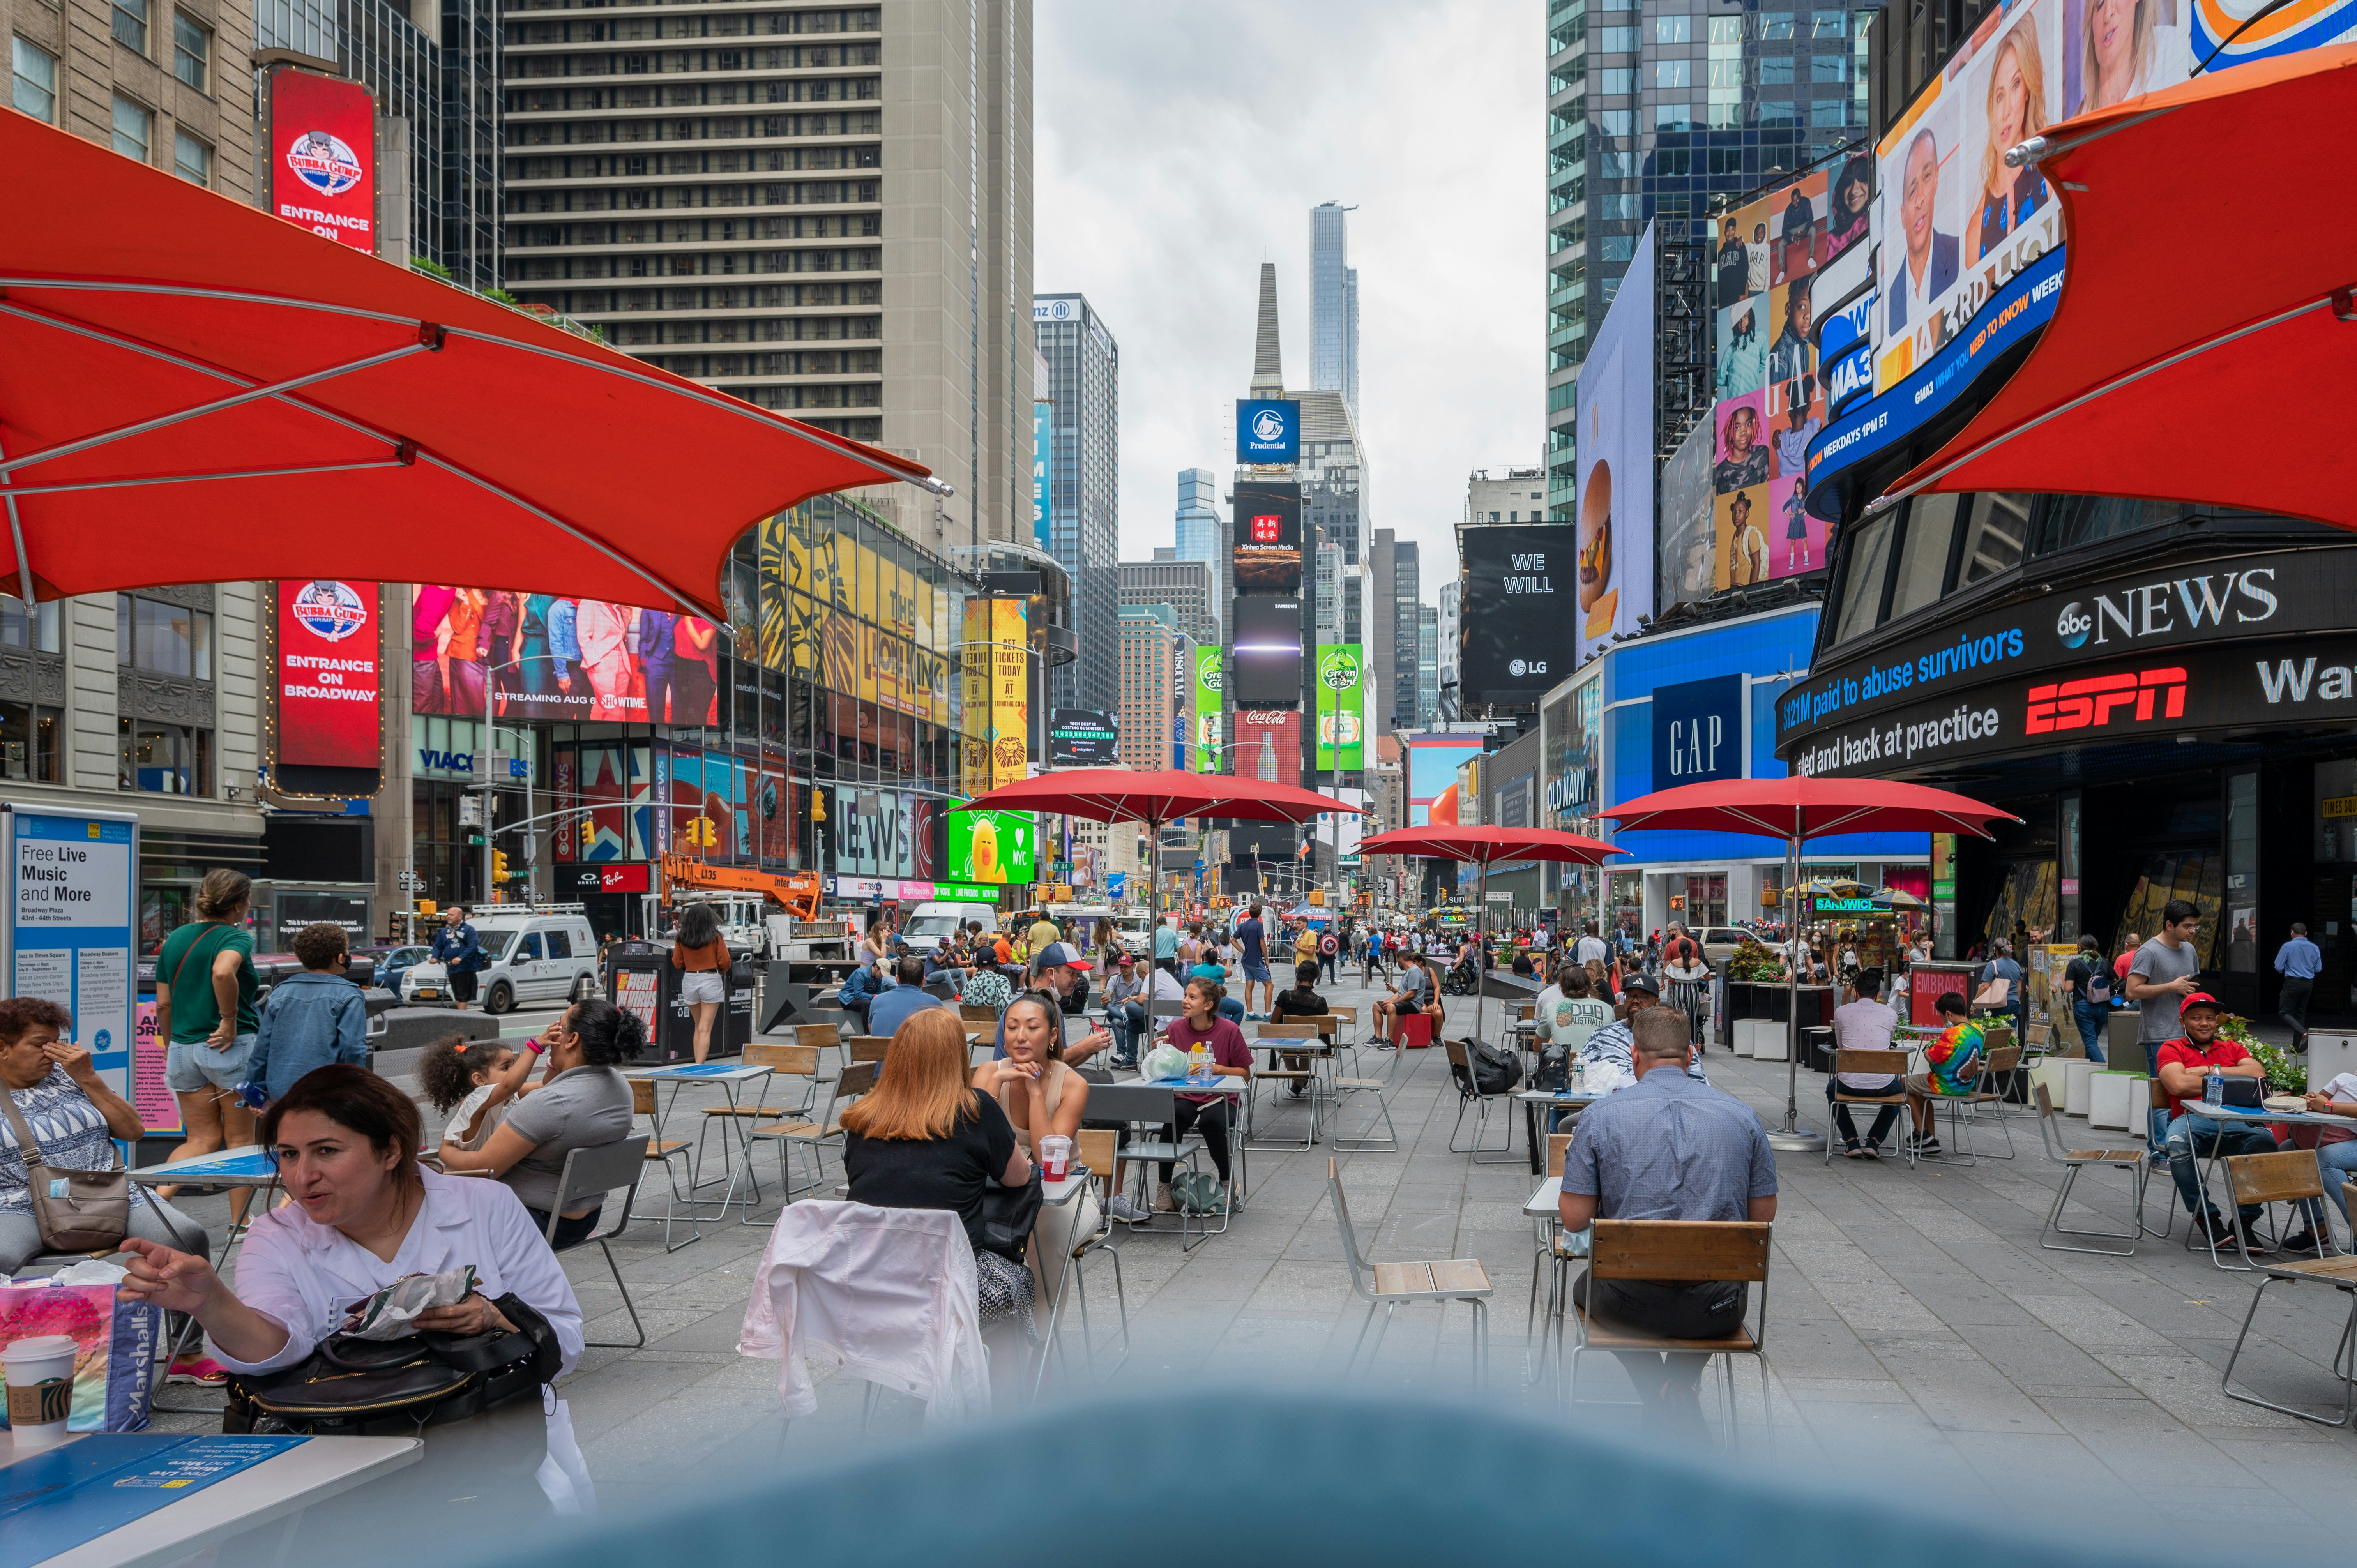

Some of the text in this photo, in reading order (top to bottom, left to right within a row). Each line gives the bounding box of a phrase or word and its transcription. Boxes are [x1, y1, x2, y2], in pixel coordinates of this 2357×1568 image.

[290, 156, 360, 178] BUBBA GUMP
[301, 168, 328, 177] SHRIMP
[281, 204, 369, 231] ENTRANCE
[313, 226, 338, 240] ON
[1719, 250, 1740, 271] GAP
[1749, 251, 1765, 265] GAP
[1915, 292, 2029, 405] GMA3 WHAT YOU NEED TO KNOW
[1823, 427, 1861, 459] WEEKDAYS
[1862, 417, 1878, 438] 1PM
[1878, 411, 1888, 429] ET
[1250, 441, 1285, 450] Prudential
[1511, 554, 1545, 570] WE
[1504, 576, 1554, 593] WILL
[296, 606, 365, 622] BUBBA GUMP
[889, 589, 915, 626] THE
[2058, 568, 2277, 645] abc NEWS
[1003, 639, 1016, 650] GET
[864, 614, 944, 696] LION KING
[995, 652, 1024, 663] TICKETS
[286, 655, 373, 673] ENTRANCE
[998, 665, 1021, 676] TODAY
[1528, 661, 1547, 674] LG
[318, 673, 343, 685] ON
[1783, 628, 2023, 732] $121M paid to abuse survivors
[2256, 657, 2357, 703] Wa
[284, 685, 376, 701] BROADWAY
[1005, 683, 1013, 694] AT
[495, 692, 647, 709] STREAMING AUG 6 SHOWTIME
[880, 695, 896, 706] ENTRANCE
[900, 700, 905, 708] ON
[917, 706, 926, 716] STREET
[2026, 667, 2187, 735] ESPN
[1246, 710, 1288, 725] Coca-Cola
[1671, 715, 1721, 775] GAP
[1817, 738, 1840, 772] and
[1843, 727, 1881, 766] back
[1885, 722, 1902, 756] at
[1907, 705, 1999, 759] practice
[419, 749, 533, 777] VIACBS
[996, 777, 1008, 785] LION
[1547, 779, 1562, 812] OLD
[1562, 769, 1587, 807] NAVY
[2324, 801, 2343, 815] TIMES
[22, 845, 87, 862] Free Live
[1013, 849, 1027, 866] NYC
[22, 865, 67, 881] Music
[603, 871, 623, 885] Ray-Ban
[701, 869, 716, 880] L135
[1562, 872, 1580, 887] OLD NAVY
[774, 877, 804, 890] Interboro
[903, 886, 913, 895] Bright
[940, 887, 951, 896] YORK
[21, 886, 91, 902] and More
[955, 888, 979, 897] LINE FRIENDS
[1679, 899, 1683, 908] 5
[626, 974, 657, 991] FIGHT
[1916, 973, 1964, 996] EMBRACE
[617, 990, 657, 1008] THE VIRUS
[1571, 1017, 1603, 1027] AUSTRALIA
[129, 1306, 150, 1420] Marshalls
